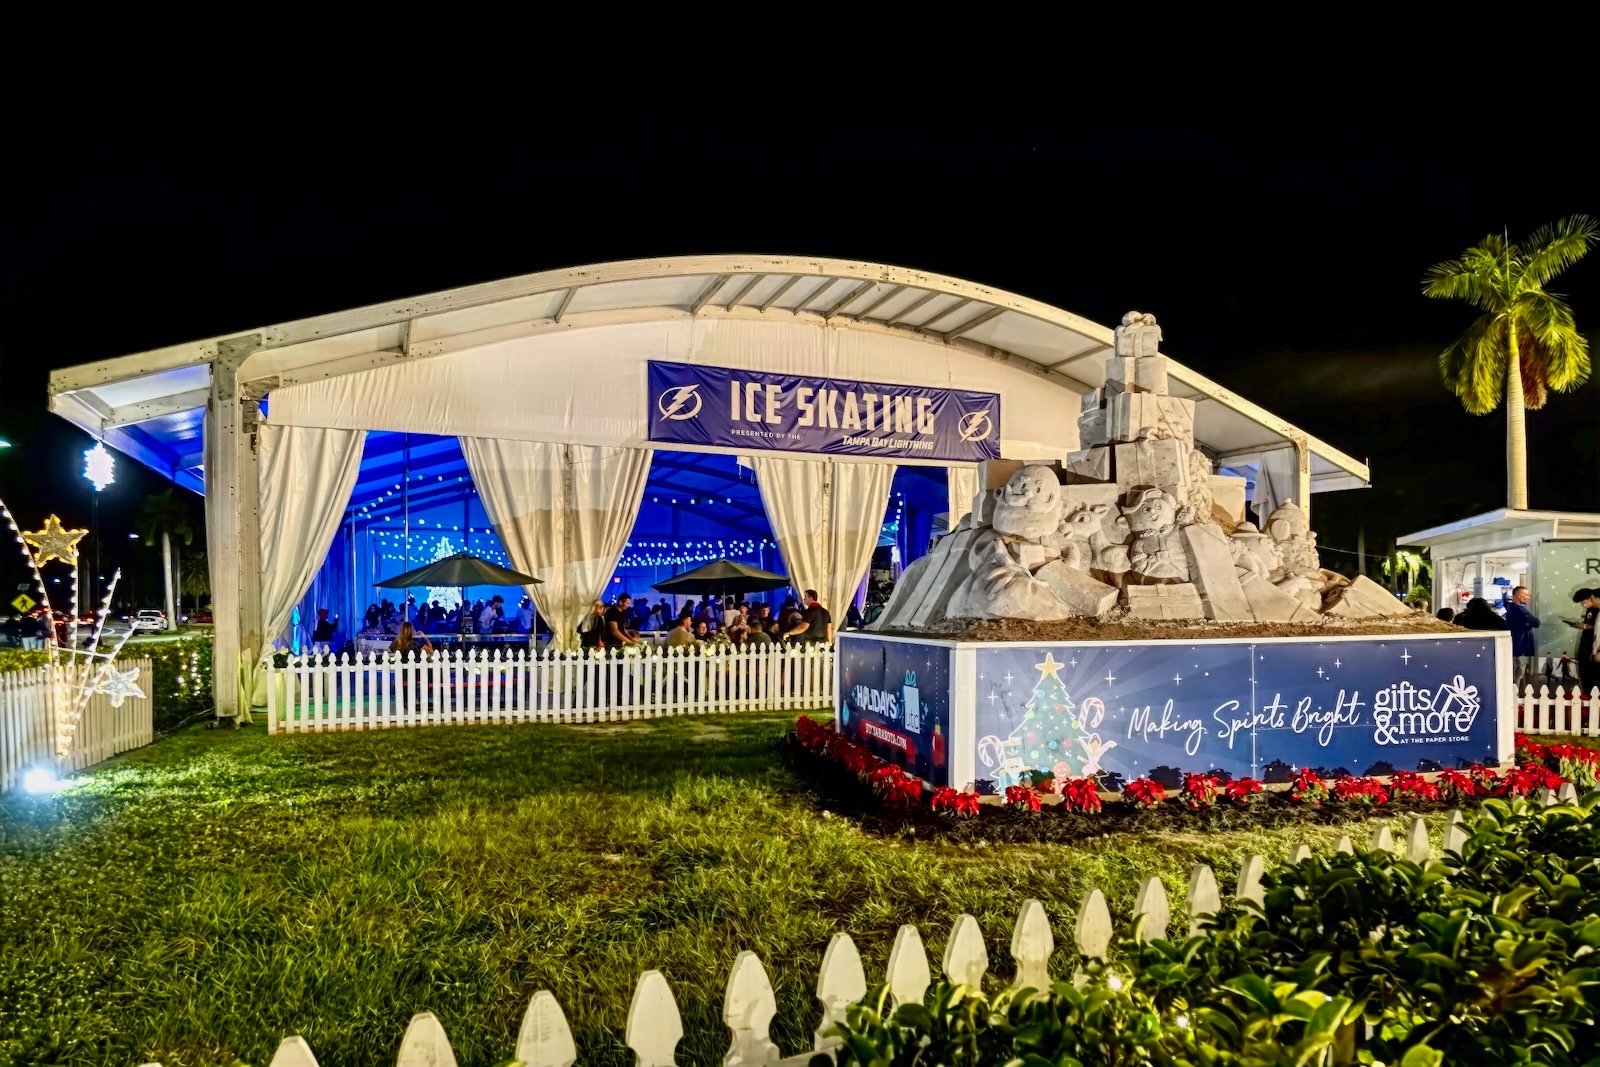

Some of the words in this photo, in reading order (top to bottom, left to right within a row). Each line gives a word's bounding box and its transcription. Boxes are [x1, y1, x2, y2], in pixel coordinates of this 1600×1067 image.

[731, 380, 782, 425] ICE
[797, 387, 935, 435] SKATING
[731, 429, 774, 439] PRESENTED
[842, 435, 872, 447] TAMPA
[872, 437, 889, 448] BAY
[888, 438, 934, 450] LIGHTNING
[1374, 680, 1432, 721] gifts
[1128, 699, 1207, 756] Making
[1213, 692, 1288, 749] Spirits
[1291, 689, 1366, 747] Bright
[1448, 735, 1470, 743] STORE
